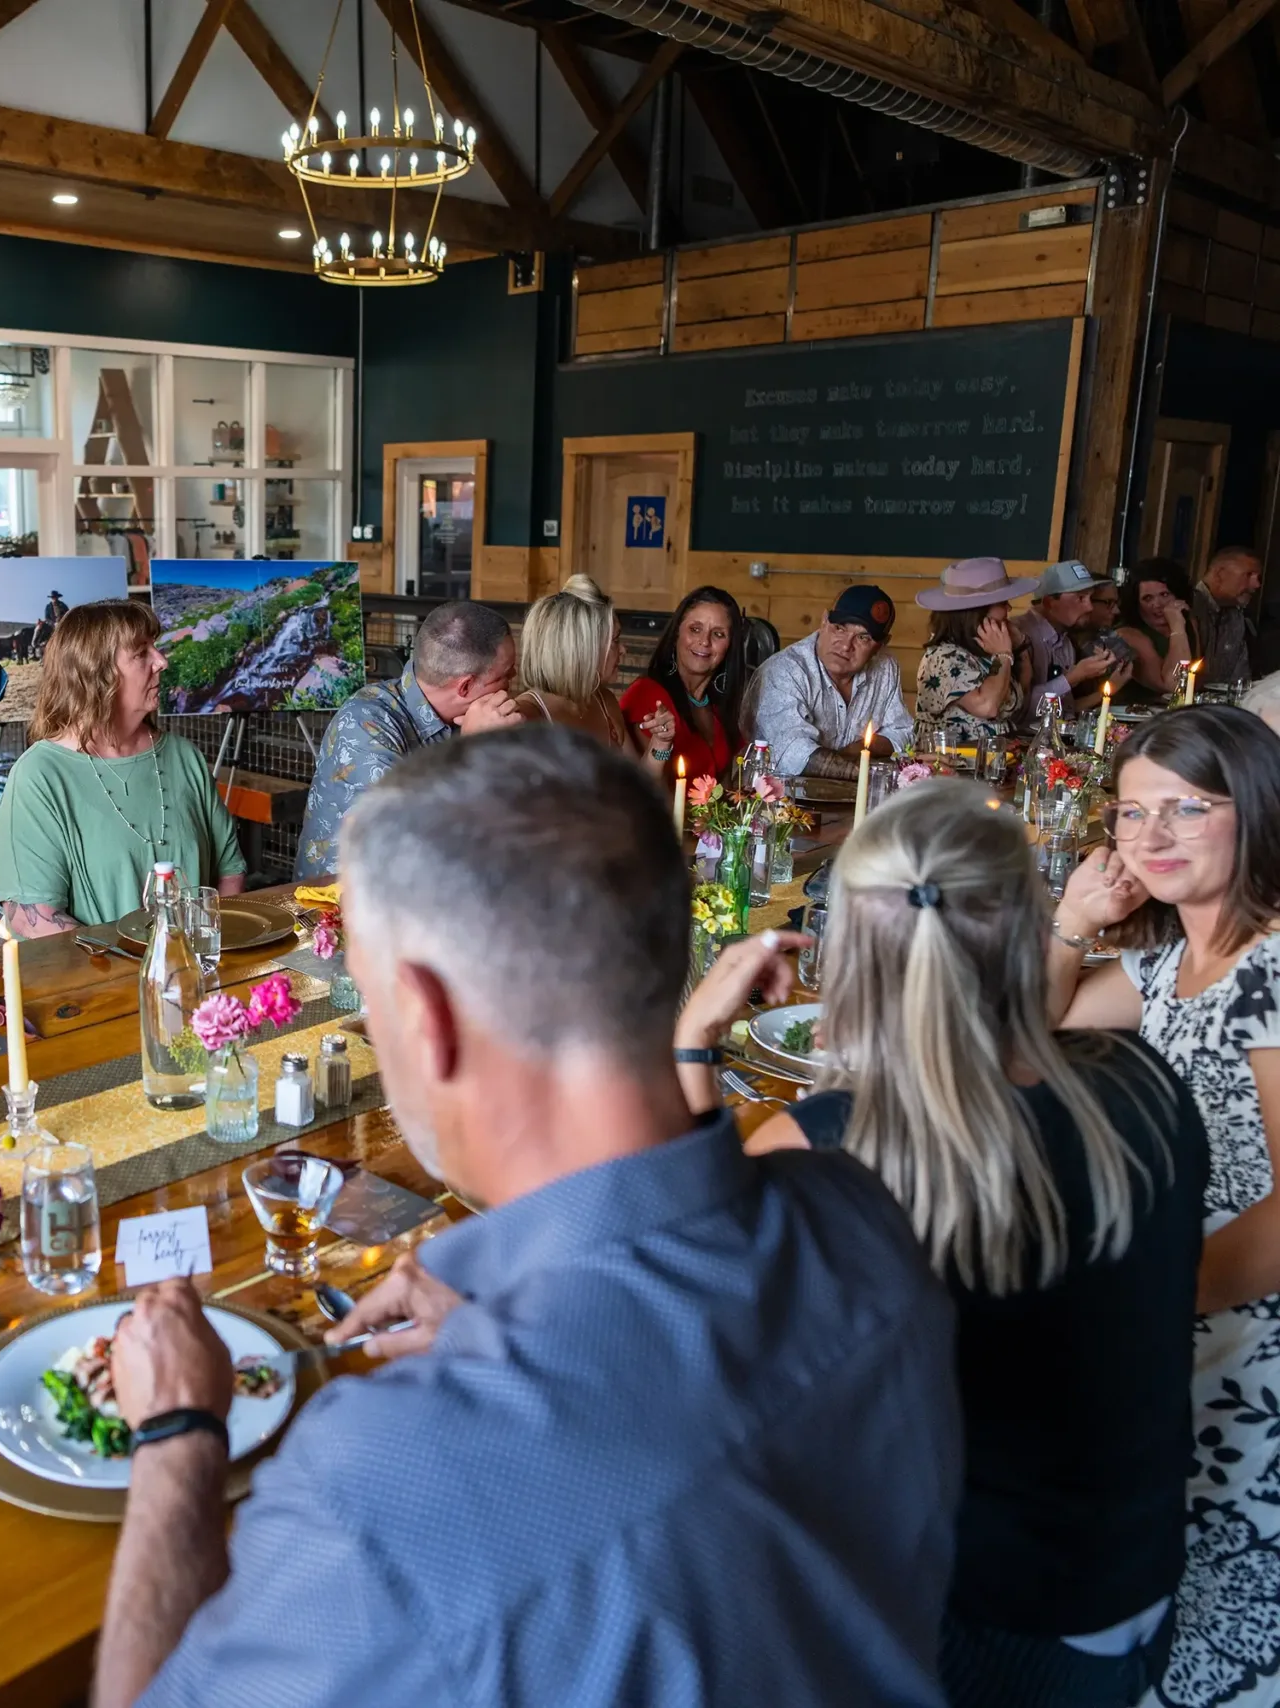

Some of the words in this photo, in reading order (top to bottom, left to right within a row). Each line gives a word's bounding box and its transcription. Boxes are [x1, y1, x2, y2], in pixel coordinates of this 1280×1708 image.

[745, 387, 818, 407] Excuses
[729, 424, 761, 445] but
[769, 423, 812, 446] they
[722, 459, 823, 482] Discipline
[901, 454, 960, 481] today
[730, 494, 761, 514] but
[771, 493, 790, 514] it
[863, 494, 956, 515] tomorrow
